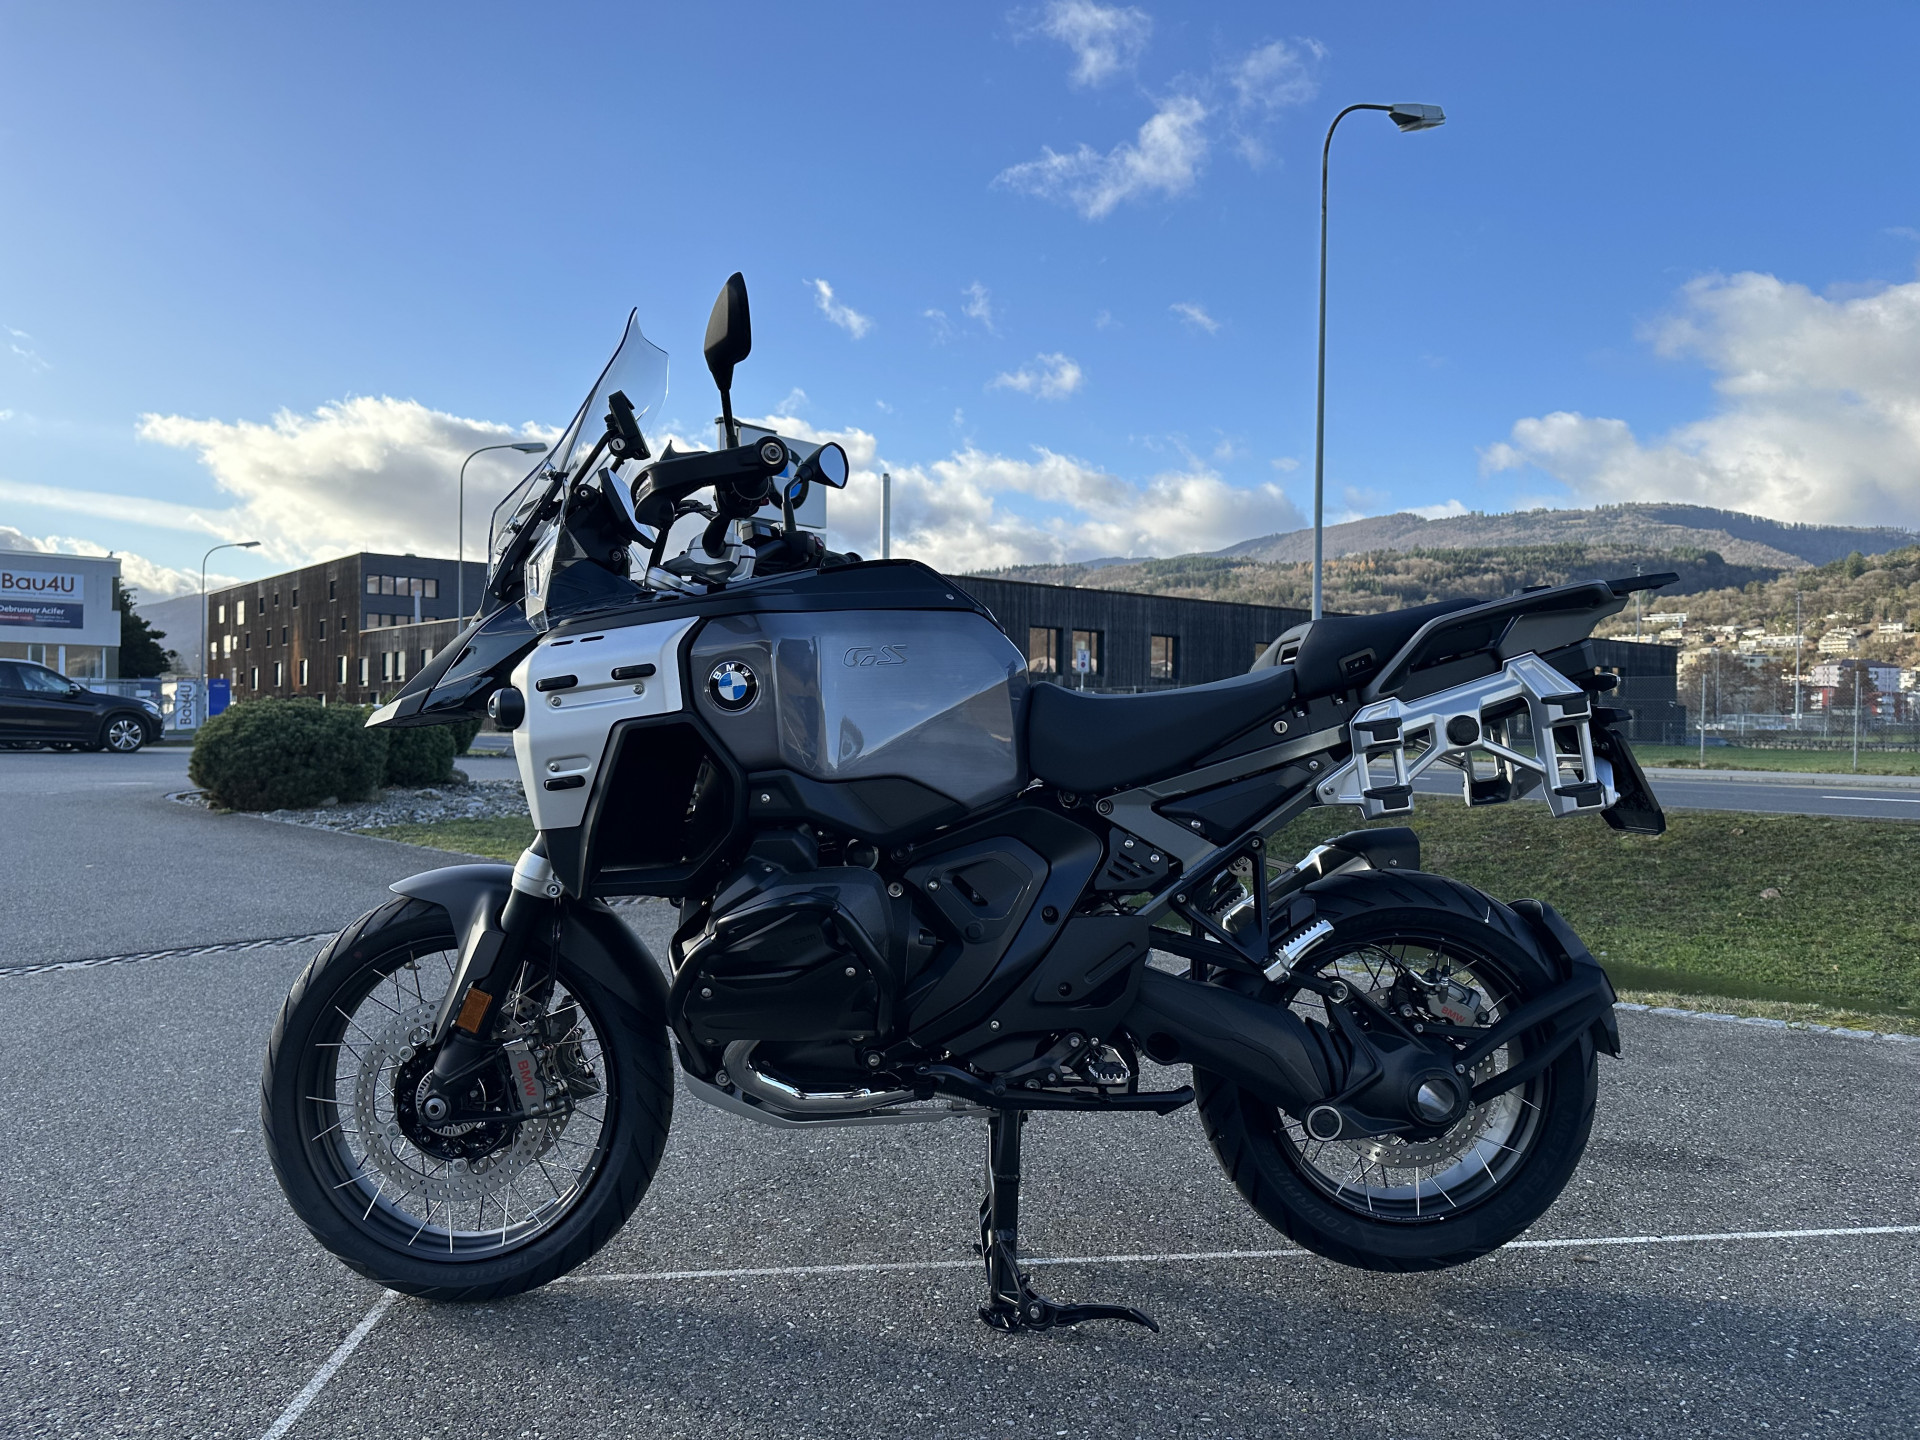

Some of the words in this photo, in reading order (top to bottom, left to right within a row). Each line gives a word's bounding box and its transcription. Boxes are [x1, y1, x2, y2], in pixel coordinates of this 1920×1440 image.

[1, 572, 75, 593] Bau4U
[0, 604, 40, 614] Debrunner
[41, 606, 65, 615] Acifer
[842, 644, 908, 668] GS
[712, 663, 751, 681] BMW
[180, 684, 192, 725] Bau4U
[1441, 1006, 1466, 1023] BMW
[517, 1060, 538, 1097] BMW
